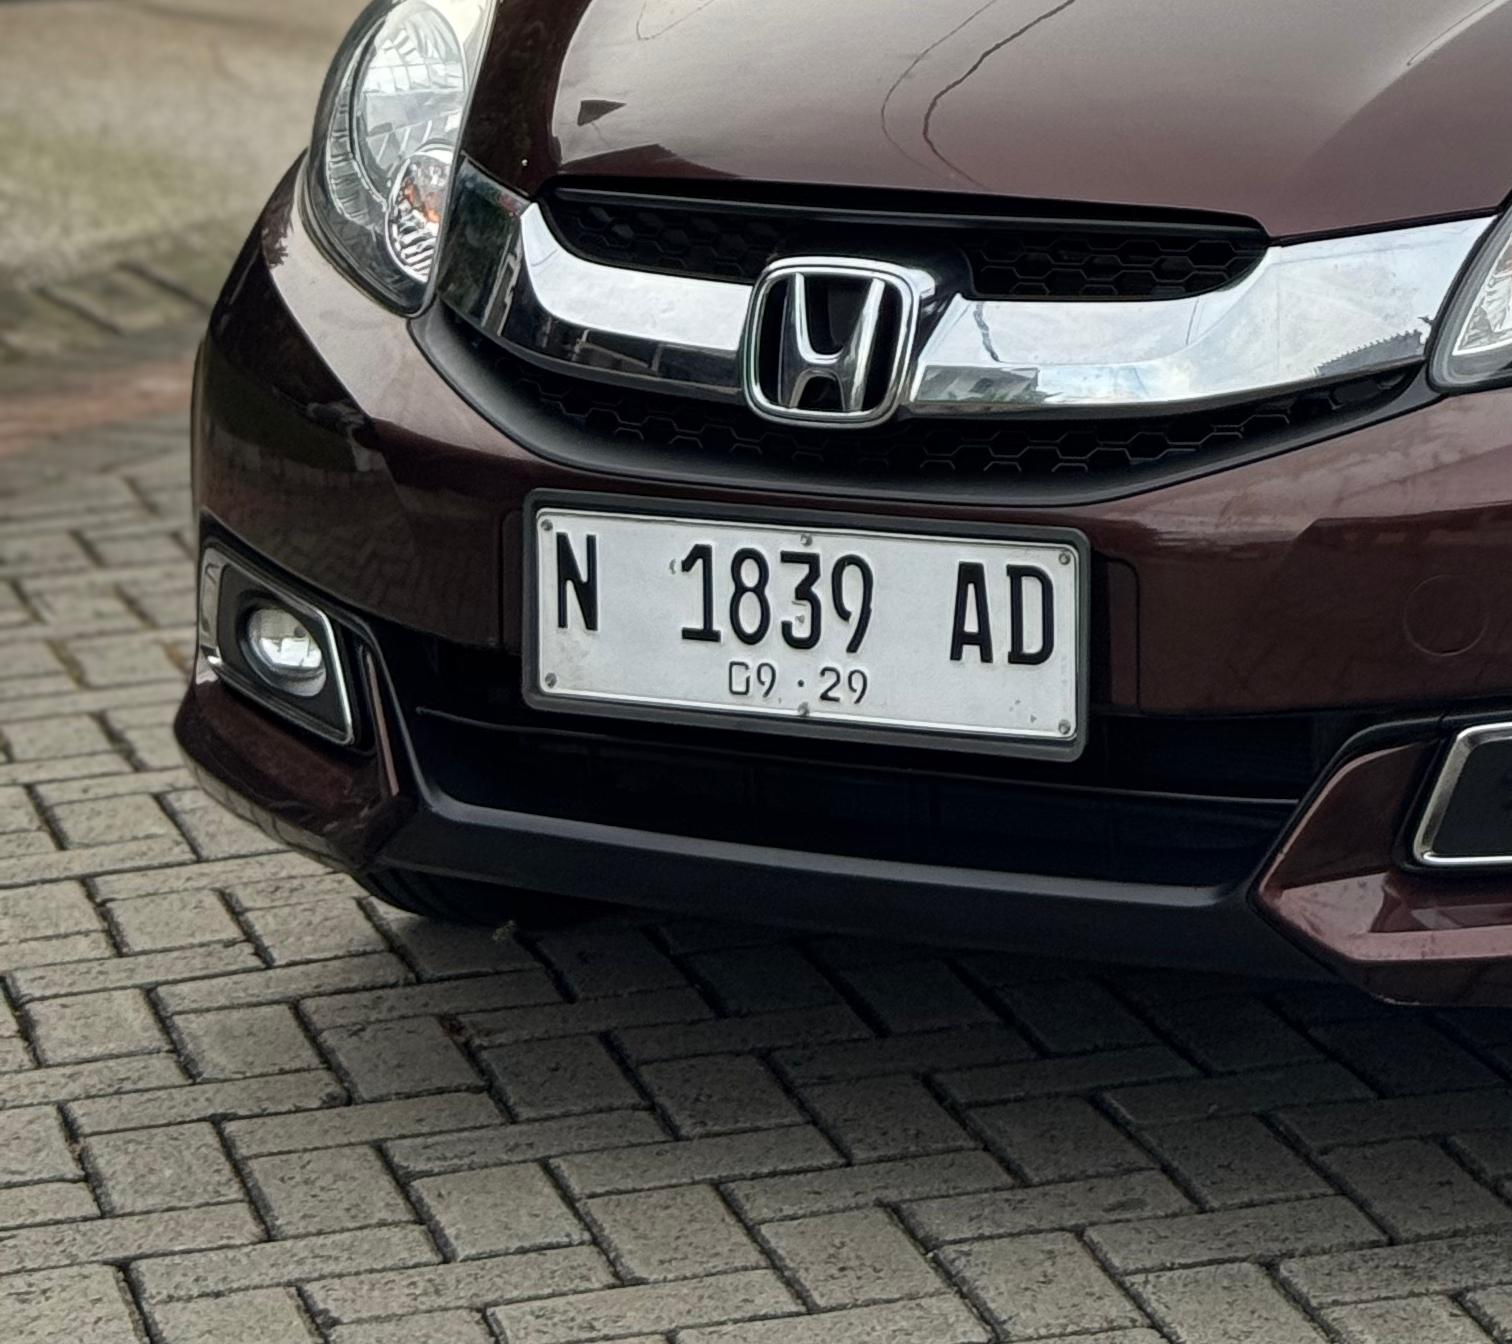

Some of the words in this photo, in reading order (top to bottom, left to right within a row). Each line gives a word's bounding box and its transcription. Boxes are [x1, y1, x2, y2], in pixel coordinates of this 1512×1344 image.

[556, 531, 599, 632] N
[680, 543, 874, 654] 1839
[949, 560, 1055, 665] AD
